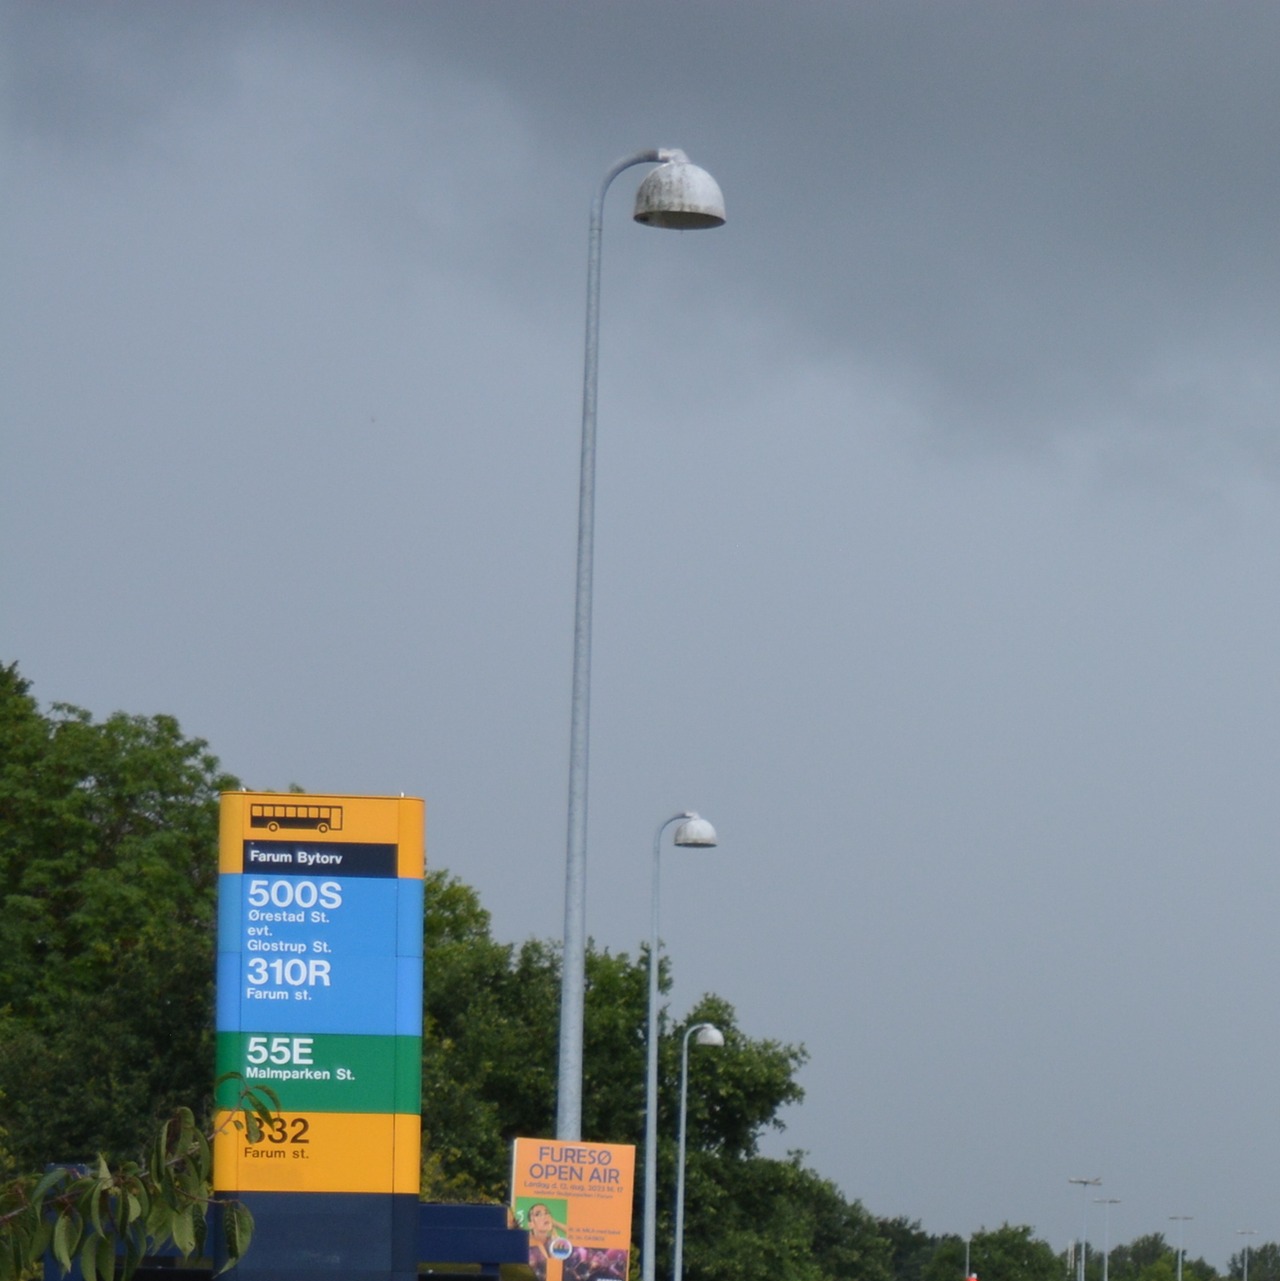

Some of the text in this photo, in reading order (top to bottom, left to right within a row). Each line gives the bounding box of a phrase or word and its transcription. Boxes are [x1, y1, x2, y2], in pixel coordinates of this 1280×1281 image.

[250, 850, 343, 865] Farum Bytorv
[248, 879, 343, 909] 500S
[248, 909, 330, 923] Ørestad St.
[247, 925, 273, 937] evt.
[247, 939, 332, 954] Glostrup St.
[247, 957, 332, 987] 310R
[246, 988, 312, 1001] Farum st.
[246, 1037, 314, 1065] 55E
[246, 1067, 355, 1082] Malmparken St.
[244, 1147, 309, 1160] Farum st.
[539, 1146, 612, 1166] FURESØ
[529, 1163, 620, 1184] OPEN AIR
